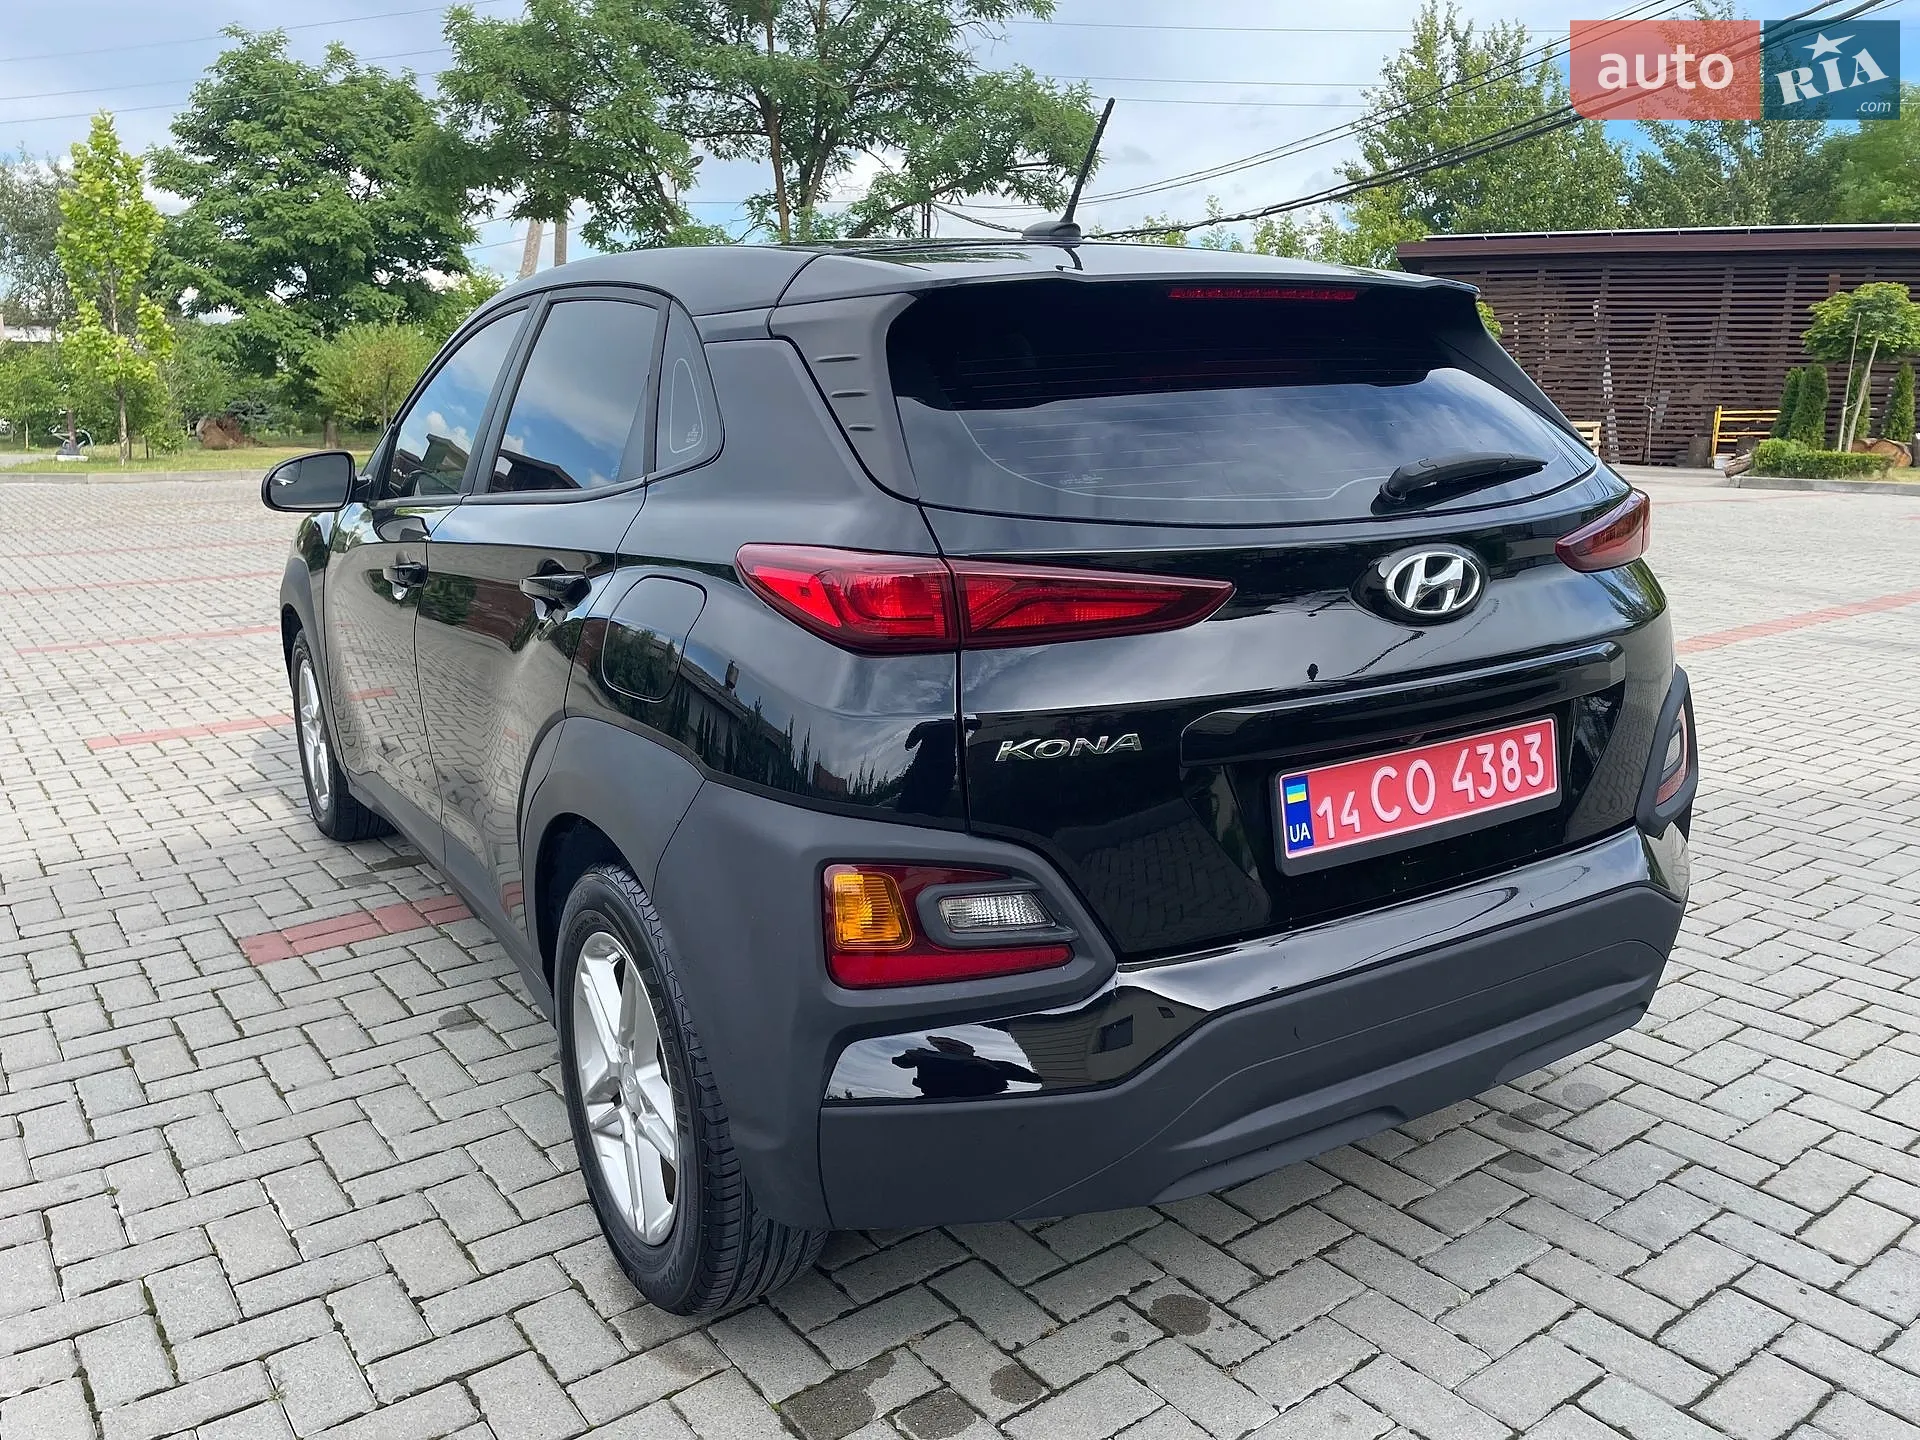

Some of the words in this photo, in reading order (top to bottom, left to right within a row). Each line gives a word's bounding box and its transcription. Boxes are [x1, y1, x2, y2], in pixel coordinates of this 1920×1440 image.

[994, 732, 1144, 762] KONA
[1316, 790, 1361, 839] 14
[1370, 758, 1436, 823] CO
[1451, 731, 1546, 804] 4383
[1288, 823, 1311, 844] UA
